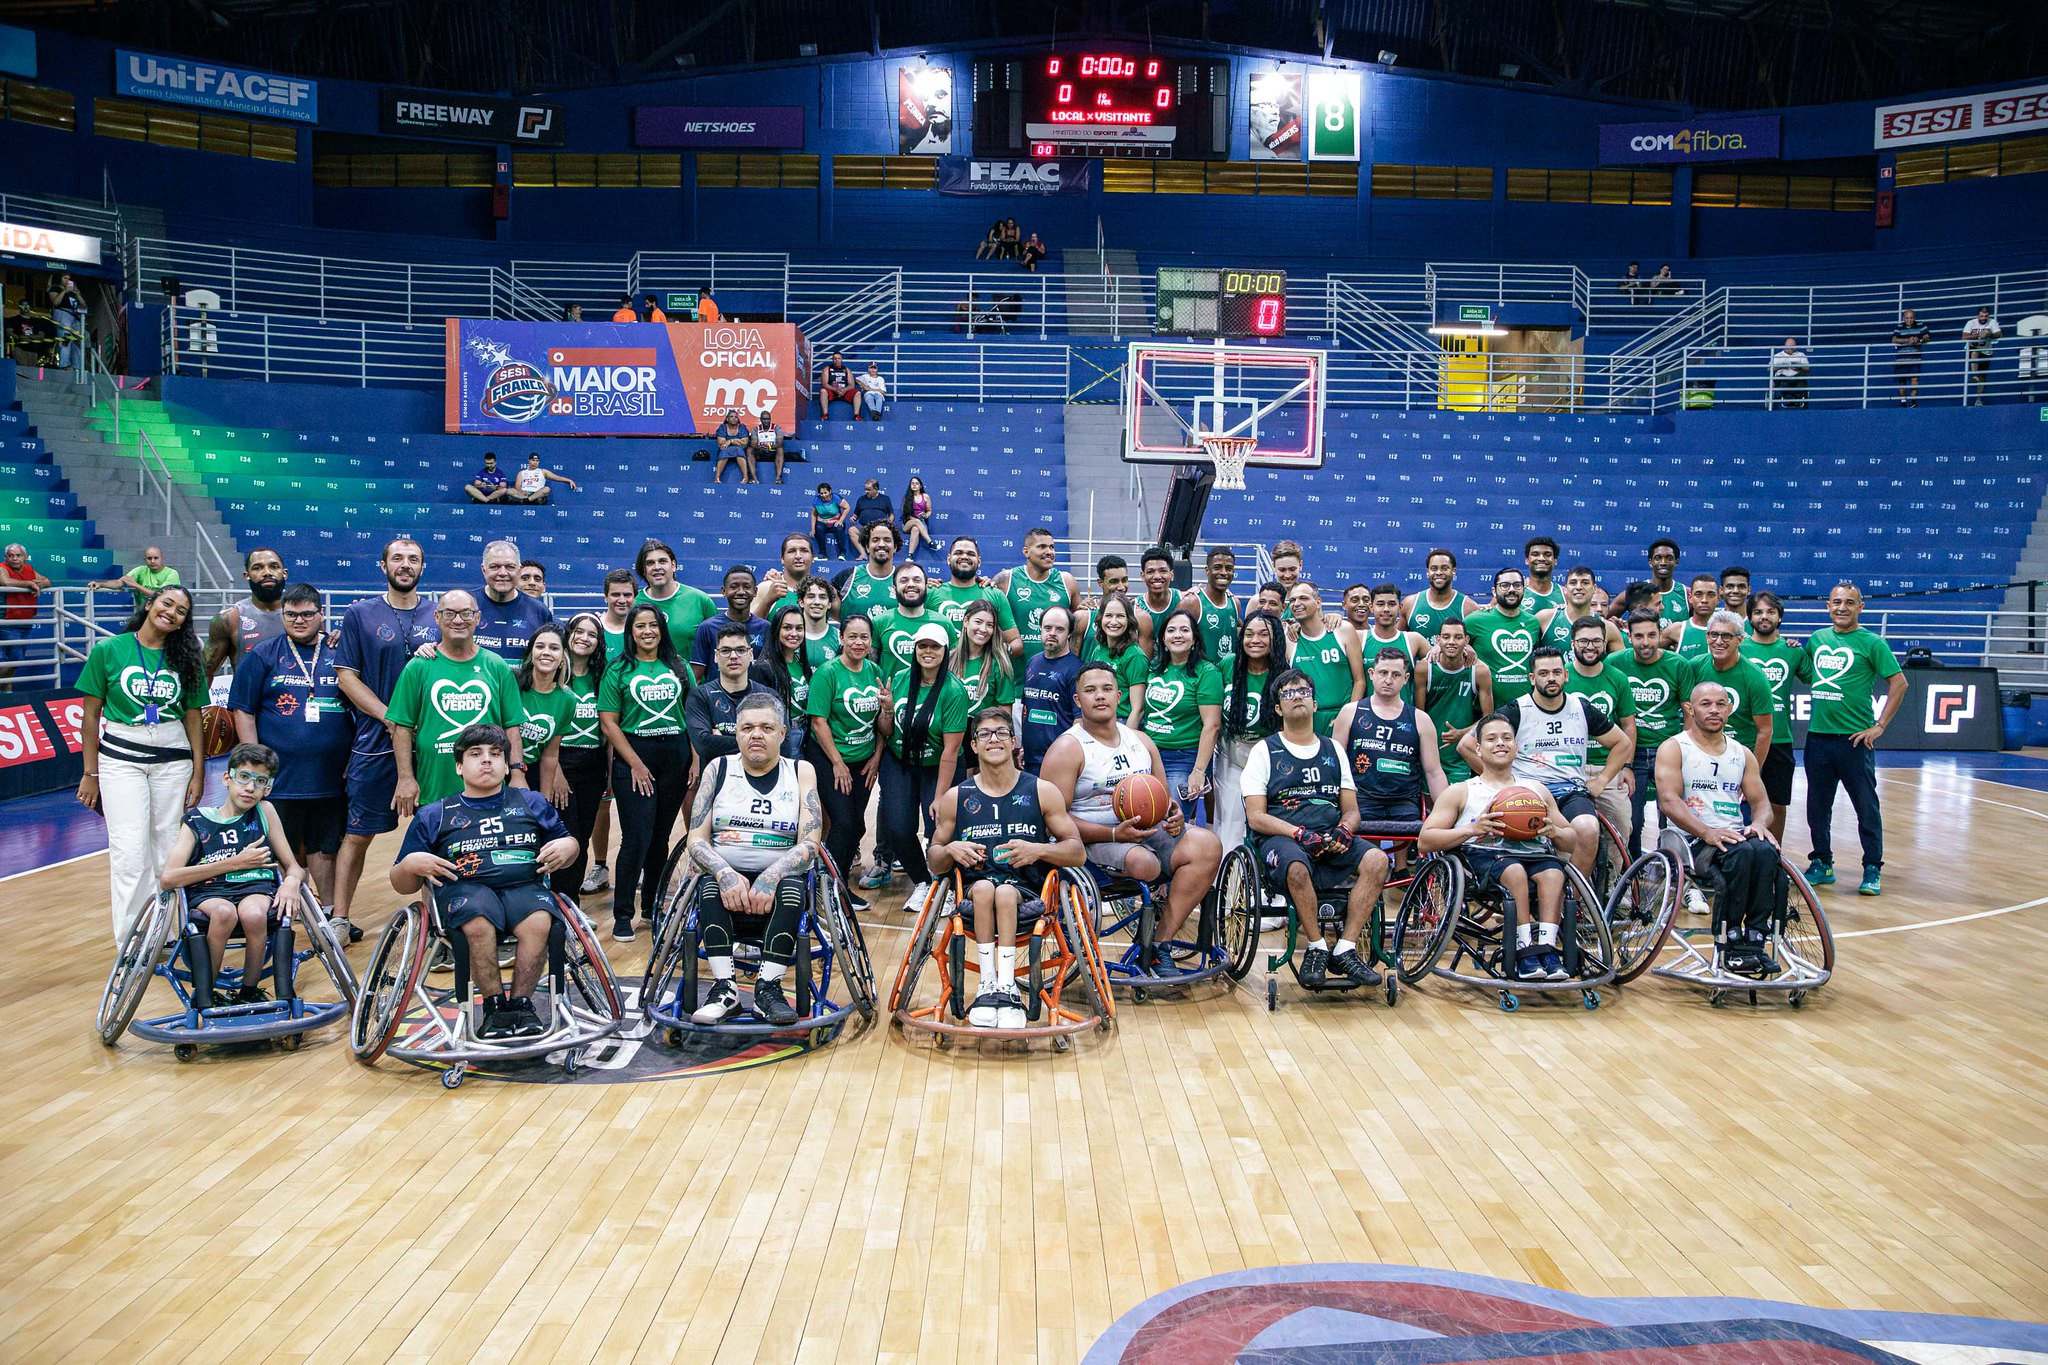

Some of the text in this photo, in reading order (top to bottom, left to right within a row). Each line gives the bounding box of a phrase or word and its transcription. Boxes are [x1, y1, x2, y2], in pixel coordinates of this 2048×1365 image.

[1049, 60, 1059, 74] 0
[1147, 62, 1158, 76] 0
[129, 56, 310, 108] Uni-FACEF
[1058, 84, 1071, 102] 0
[1156, 89, 1170, 107] 0
[131, 87, 162, 100] Centro
[224, 99, 267, 117] Municipal
[269, 107, 281, 117] de
[396, 101, 494, 126] FREEWAY
[1324, 100, 1345, 131] 8
[1992, 96, 2048, 123] SES
[1052, 112, 1086, 121] LOCAL
[1095, 112, 1152, 123] VISITANTE
[1890, 107, 1965, 136] SESI
[684, 122, 757, 132] NETSHOES
[971, 162, 1060, 182] FEAC
[1226, 273, 1281, 293] 00:00
[1257, 299, 1279, 330] 0
[704, 328, 765, 350] LOJA
[700, 351, 777, 368] OFICIAL
[499, 367, 526, 380] SESI
[553, 367, 657, 392] MAIOR
[491, 378, 548, 404] FRANCA
[551, 392, 664, 416] do BRASIL
[950, 613, 964, 622] VER
[897, 645, 915, 655] VER
[1500, 643, 1529, 653] VERDE
[1321, 648, 1340, 664] 09
[1818, 660, 1844, 671] VERDE
[284, 678, 313, 687] FRANC
[320, 677, 340, 685] FEA
[640, 683, 675, 692] setembro
[130, 685, 174, 700] VERDE
[640, 689, 675, 702] VERDE
[1039, 689, 1060, 701] FEAC
[1458, 681, 1472, 697] 17
[441, 692, 483, 701] setembro
[794, 691, 808, 702] VER
[442, 700, 483, 712] VERDE
[523, 721, 548, 734] embro
[1375, 725, 1393, 740] 27
[1546, 721, 1563, 735] 32
[0, 712, 39, 760] SI
[1563, 737, 1585, 745] FEAC
[1361, 742, 1386, 751] FRANCA
[1390, 743, 1414, 755] FEAC
[1535, 740, 1560, 748] FRANCA
[1113, 754, 1130, 771] 34
[1710, 761, 1719, 777] 7
[1301, 766, 1320, 784] 30
[1691, 782, 1718, 790] FRANCA
[1722, 781, 1741, 791] FEA
[750, 798, 772, 815] 23
[1506, 799, 1546, 809] PENAL
[992, 803, 999, 820] 1
[478, 815, 504, 835] 25
[729, 820, 764, 829] FRANCA
[731, 815, 765, 823] PREFEITURA
[772, 820, 797, 831] FEA
[972, 828, 1002, 837] FRANCA
[1007, 823, 1037, 835] FEAC
[219, 829, 239, 845] 13
[461, 836, 499, 846] PREFEITURA
[505, 833, 537, 845] FEAC
[461, 840, 499, 854] FRANCA
